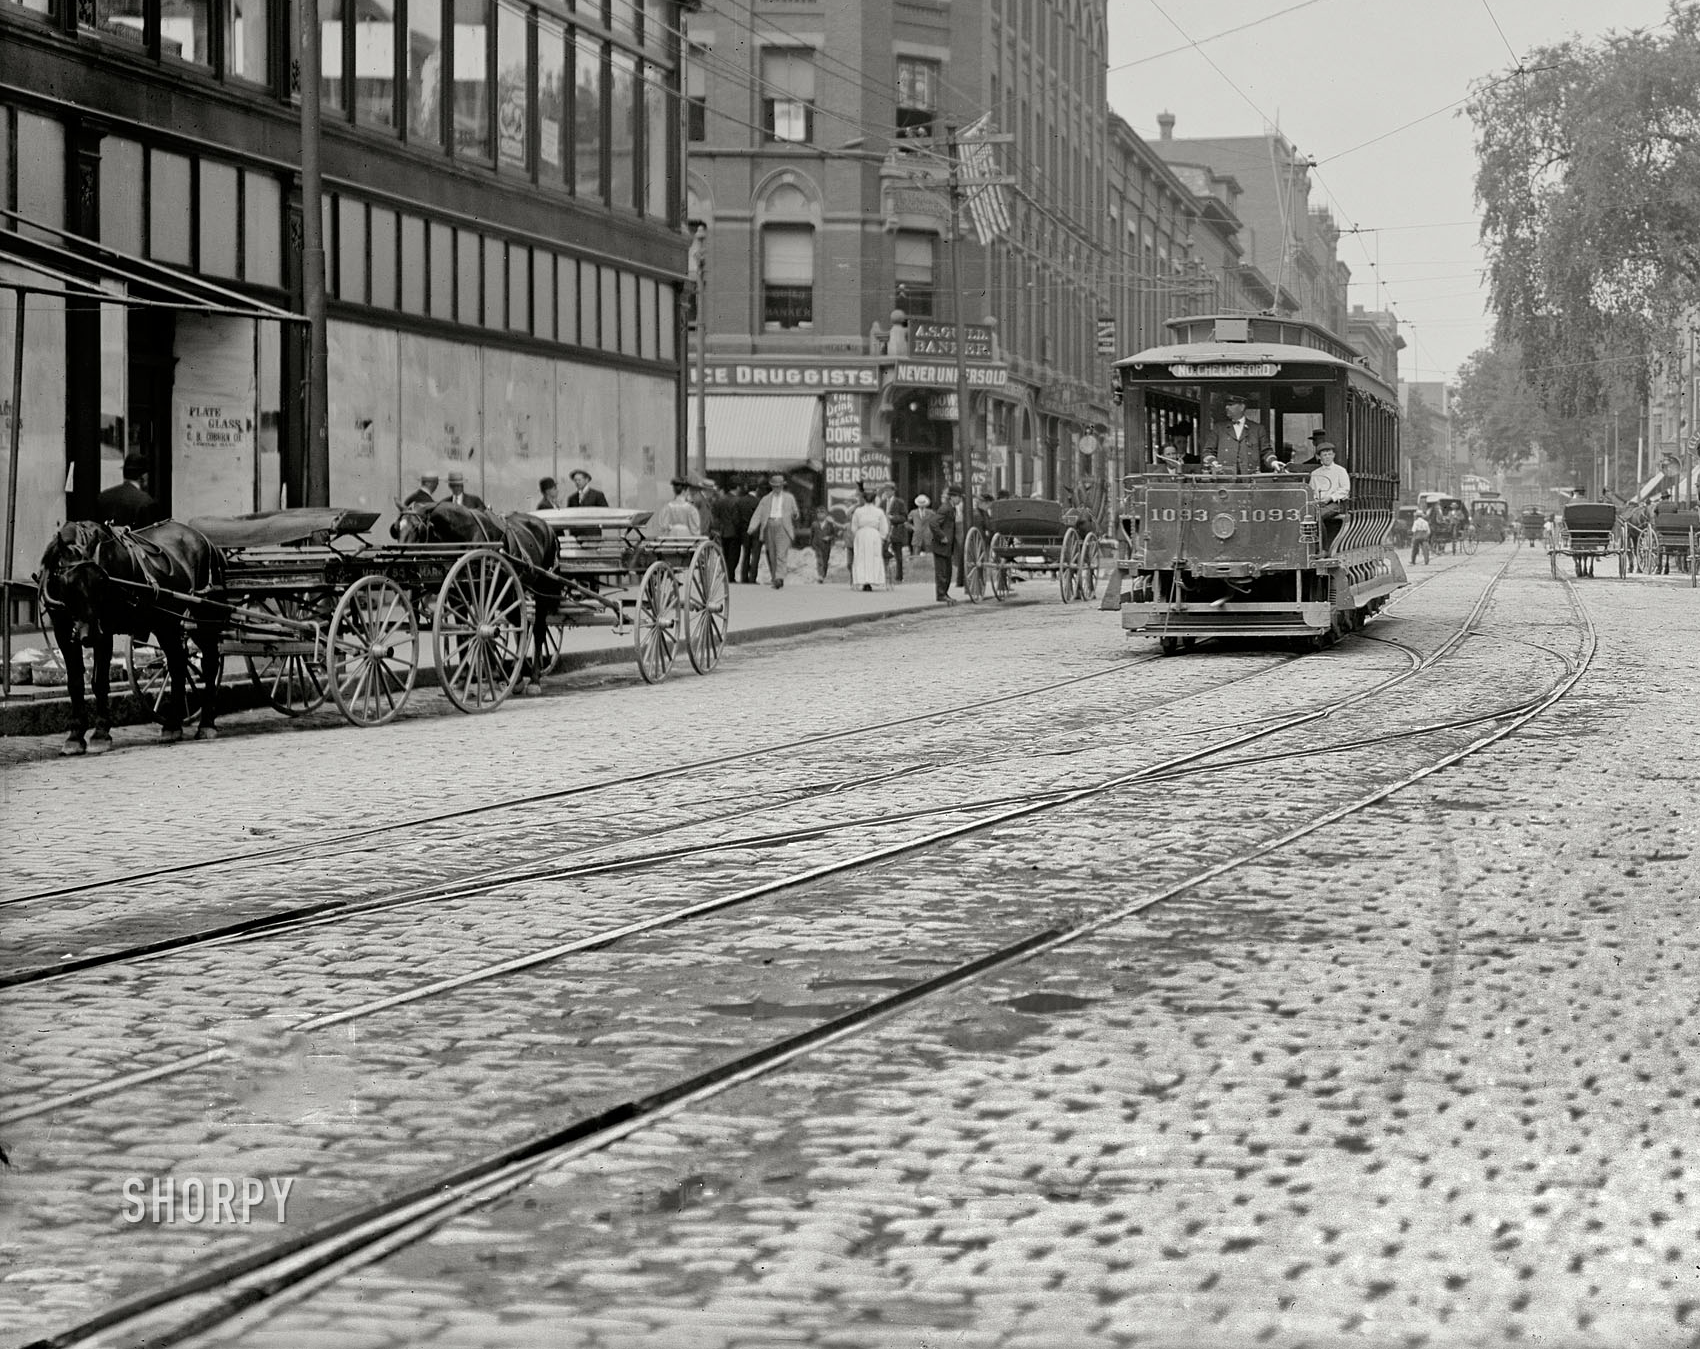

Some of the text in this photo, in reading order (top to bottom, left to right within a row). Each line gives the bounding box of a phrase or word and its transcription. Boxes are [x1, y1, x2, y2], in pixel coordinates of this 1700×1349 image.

[735, 365, 879, 386] DRUGGISTS.
[897, 366, 937, 383] NEVER
[1178, 362, 1272, 377] NO. CHELMSFORD
[189, 407, 221, 418] PLATE
[826, 400, 854, 417] Drink
[208, 419, 242, 431] GLASS
[828, 415, 860, 427] HEALTH
[825, 426, 861, 444] DOWS
[825, 446, 861, 464] ROOT
[825, 466, 861, 484] BEER
[860, 465, 891, 481] SODA
[1150, 508, 1300, 522] 1093 1093
